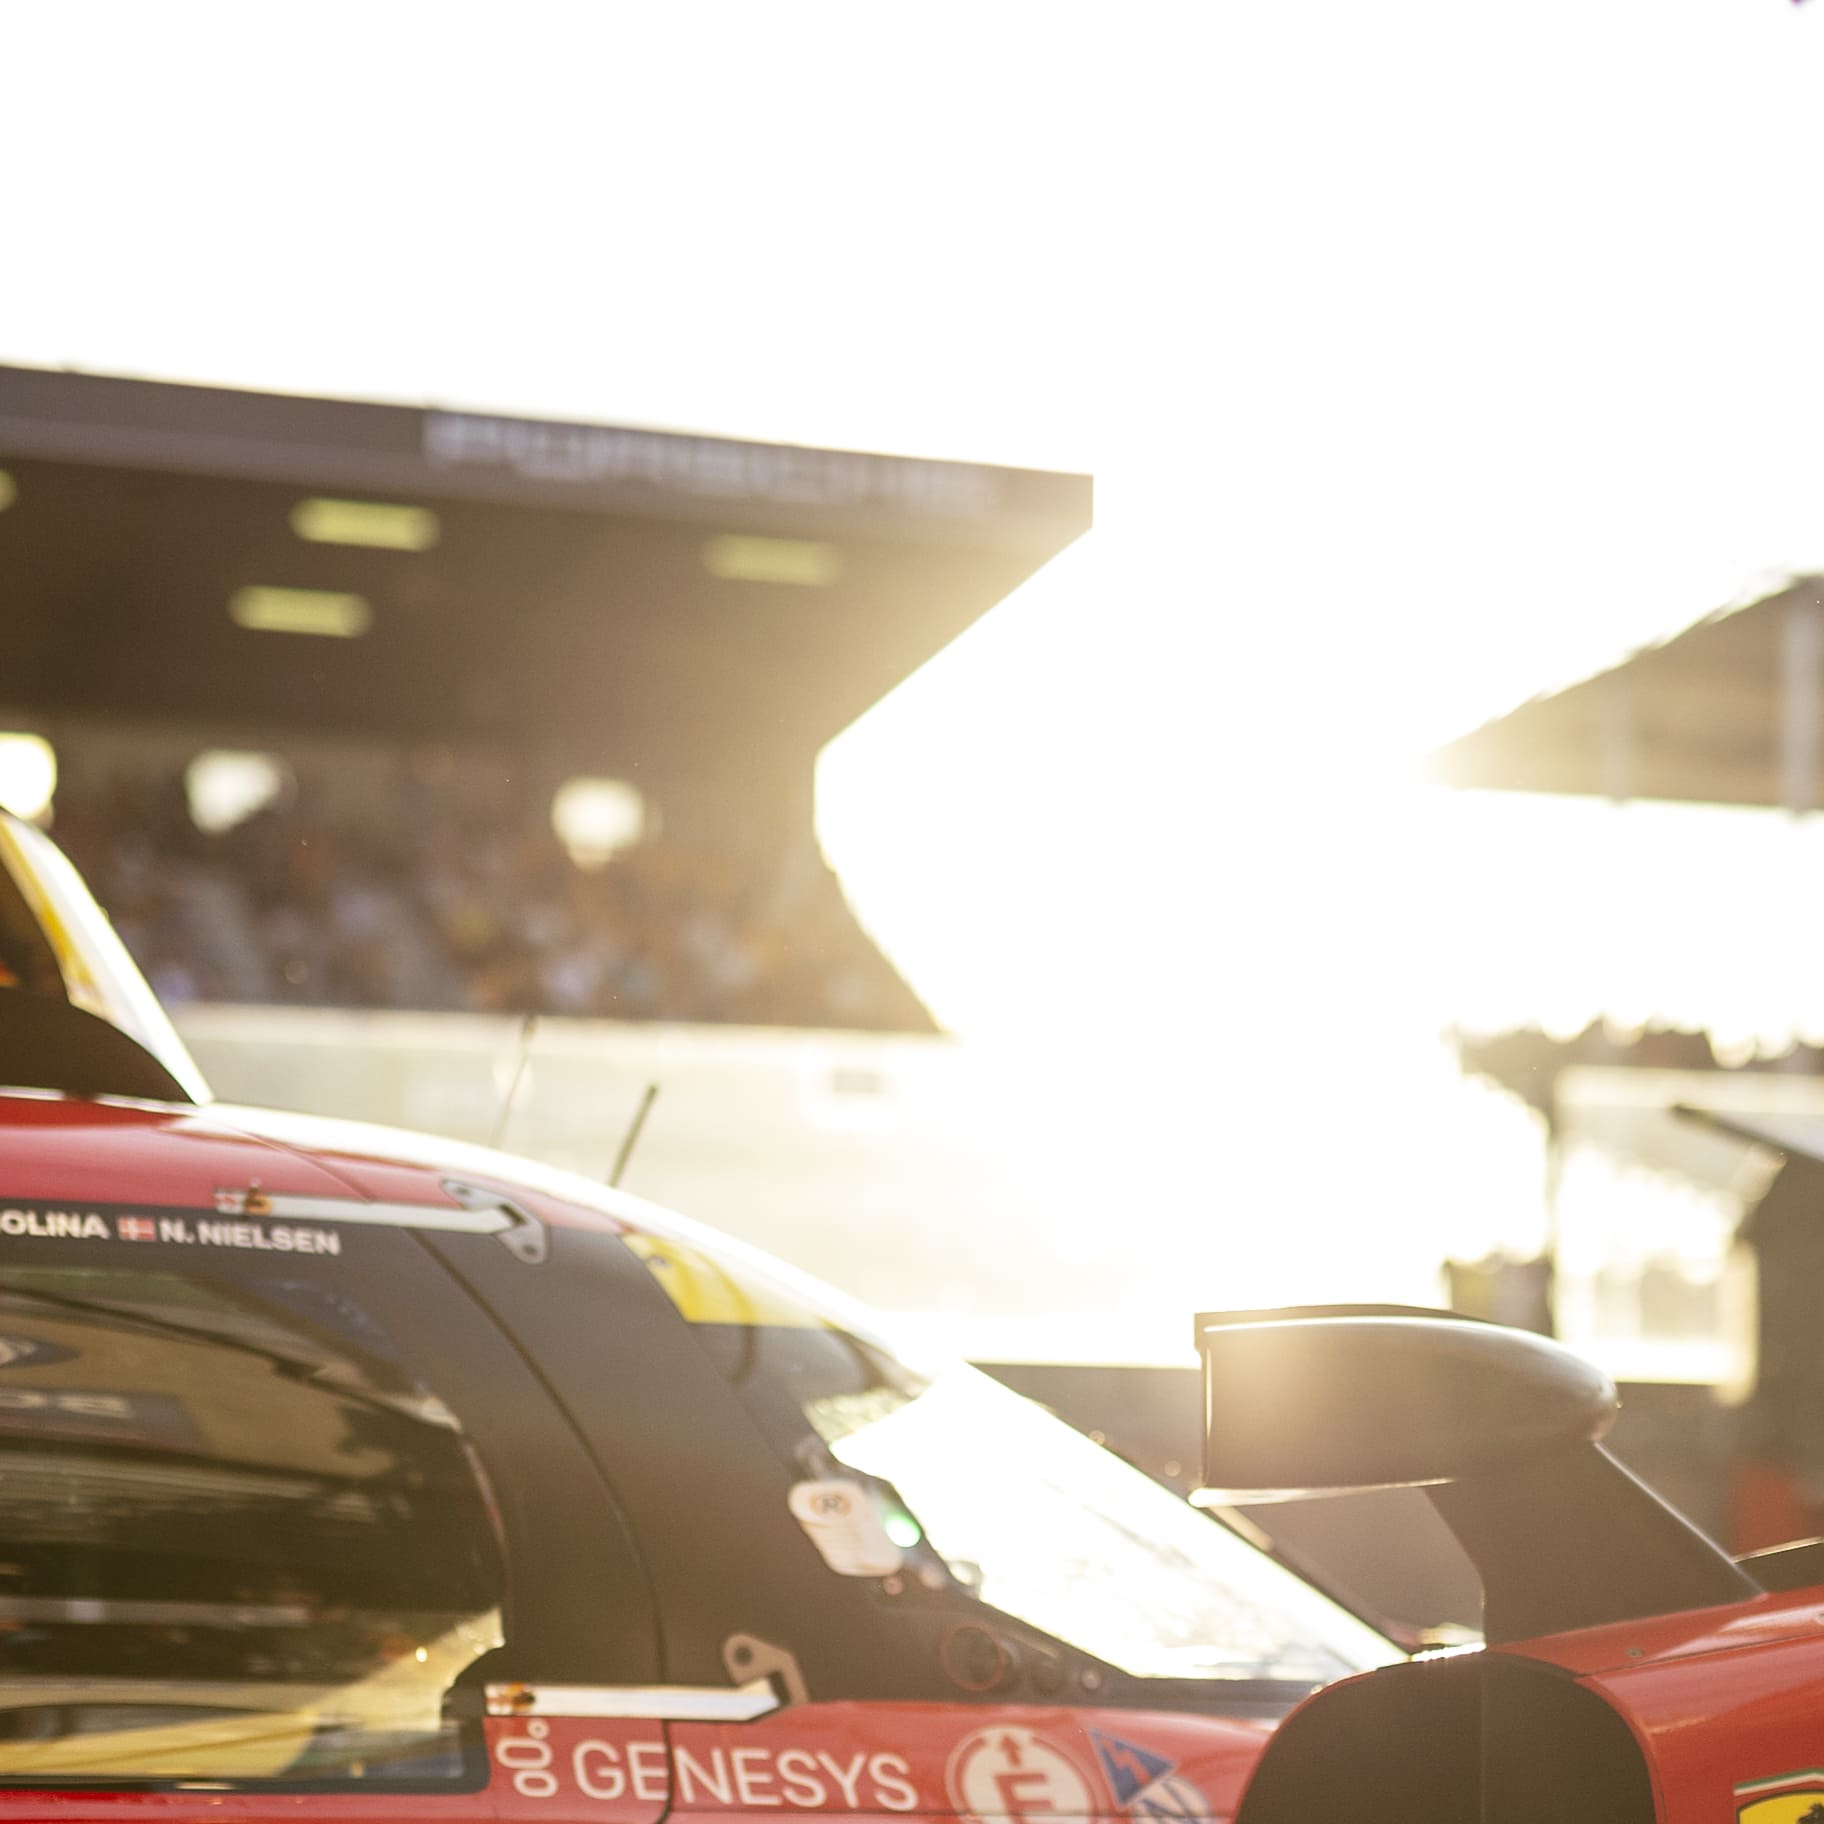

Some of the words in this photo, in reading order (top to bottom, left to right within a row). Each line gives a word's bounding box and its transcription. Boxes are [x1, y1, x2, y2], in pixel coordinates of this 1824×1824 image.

[160, 1219, 194, 1244] N.
[199, 1221, 340, 1256] NIELSEN
[574, 1742, 919, 1812] GENESYS
